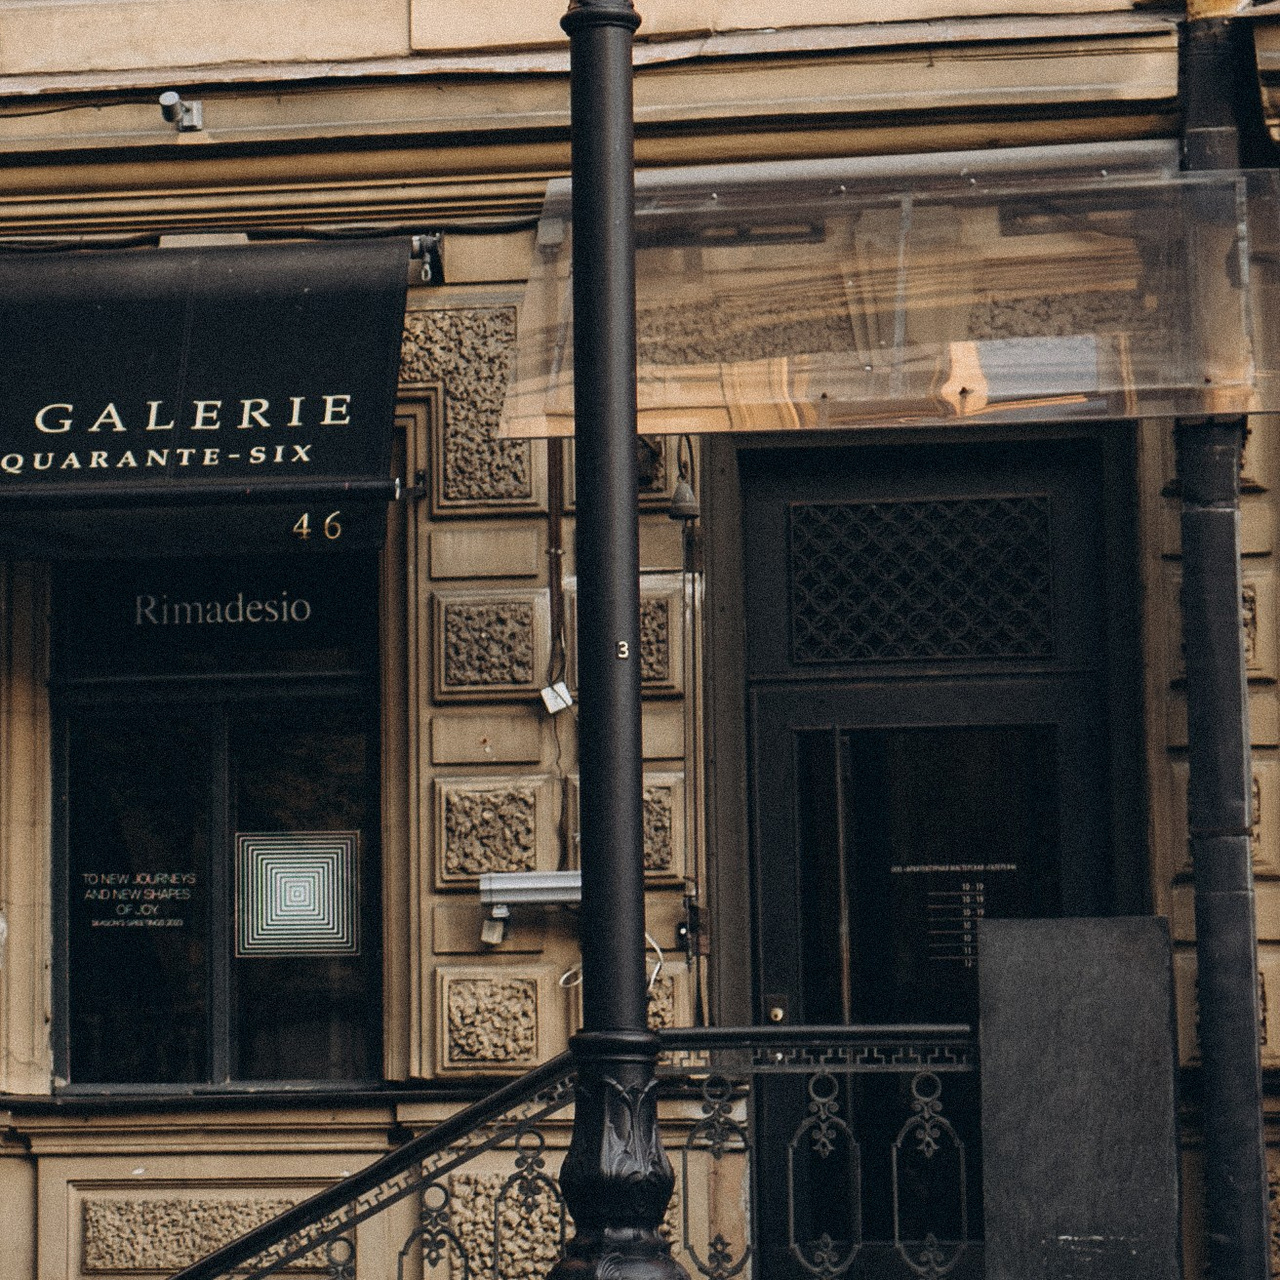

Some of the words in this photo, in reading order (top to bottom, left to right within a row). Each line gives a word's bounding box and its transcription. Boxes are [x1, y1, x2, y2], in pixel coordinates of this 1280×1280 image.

[34, 394, 352, 434] GALERIE
[0, 444, 312, 475] QUARANTE-SIX
[293, 510, 343, 540] 46
[136, 590, 312, 625] Rimadesio
[617, 640, 629, 658] 3
[82, 872, 99, 885] TO
[100, 873, 130, 885] NEW
[132, 872, 196, 885] JOURNEYS
[112, 888, 142, 900] NEW
[143, 888, 191, 900] SHAPES
